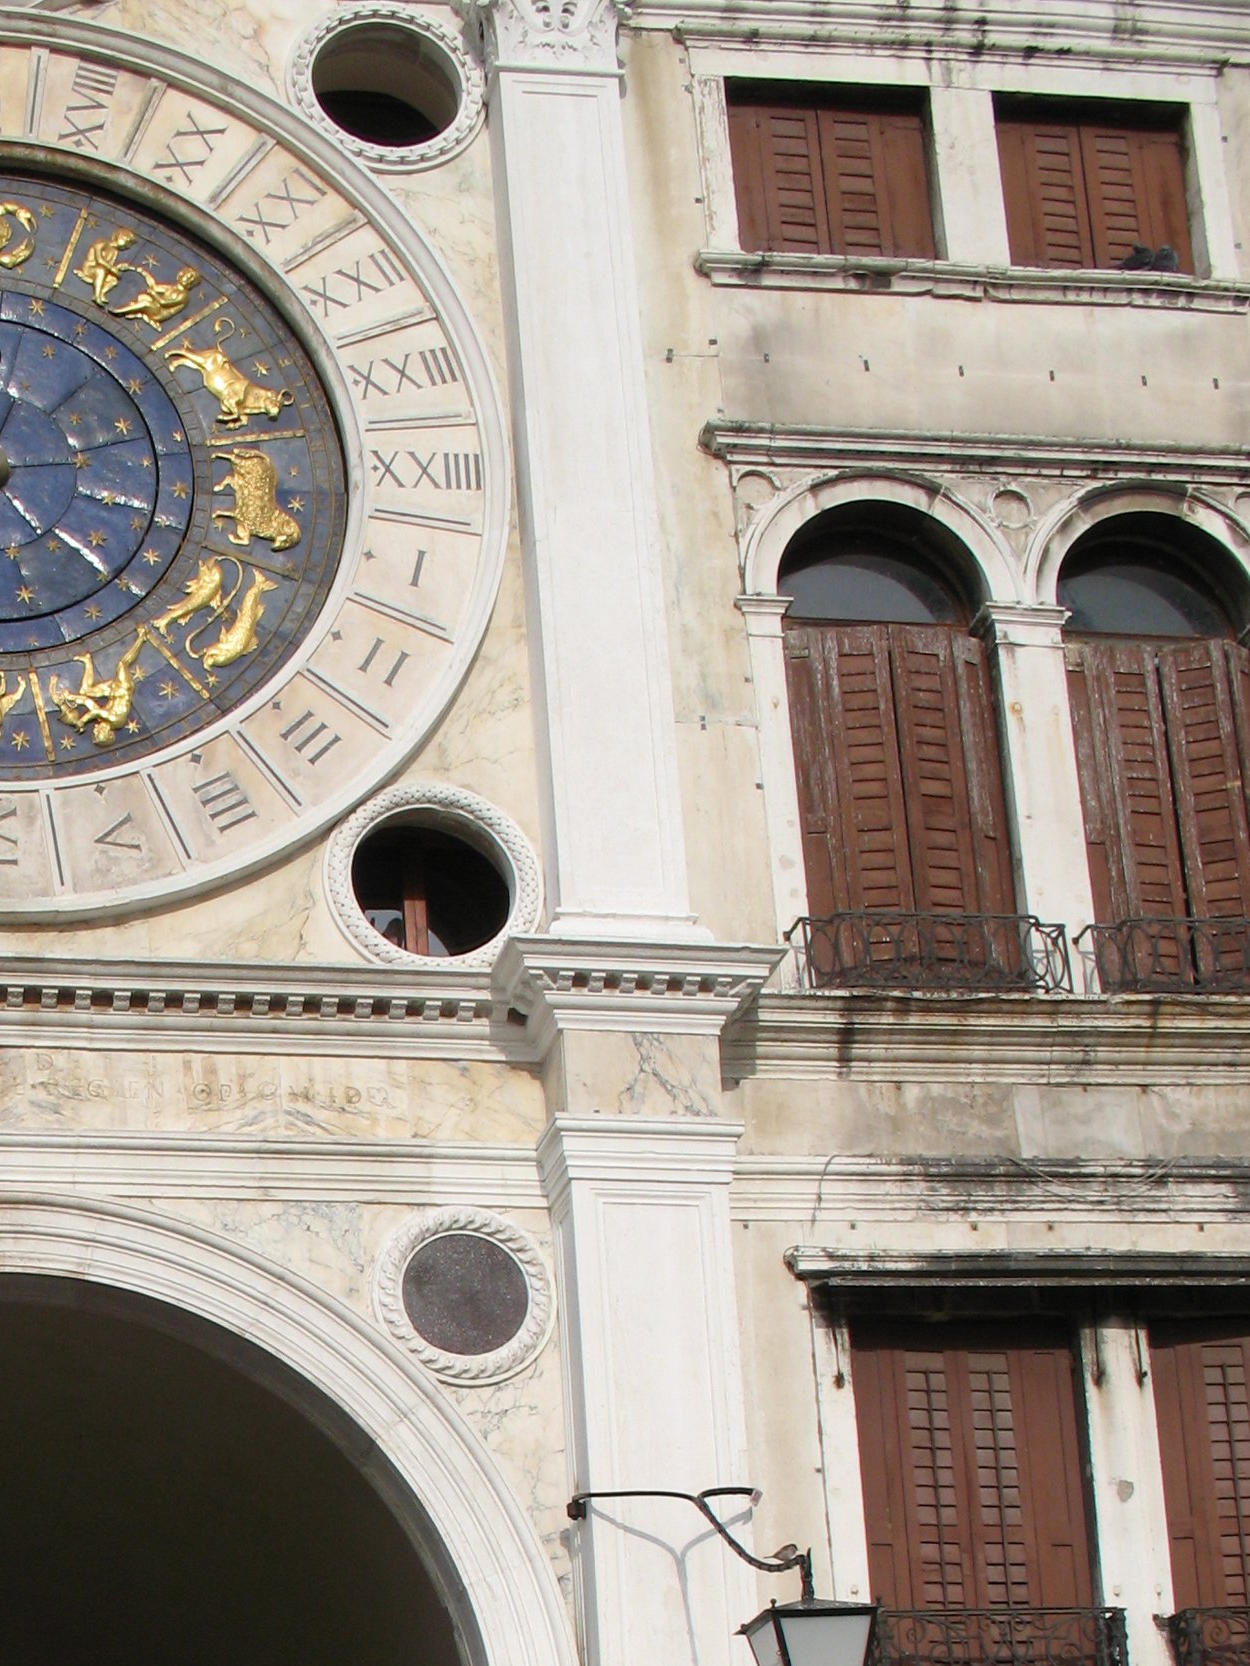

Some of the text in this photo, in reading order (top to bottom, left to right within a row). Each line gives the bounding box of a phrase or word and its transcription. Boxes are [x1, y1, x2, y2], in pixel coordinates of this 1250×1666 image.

[154, 111, 228, 186] XX
[237, 168, 327, 245] XXI
[301, 249, 406, 317] XXII
[347, 346, 458, 399] XXIII
[371, 450, 482, 490] XXIIII
[408, 549, 426, 588] I
[358, 637, 410, 687] II
[279, 710, 343, 765] III
[192, 769, 259, 833] IIII
[93, 812, 142, 852] V
